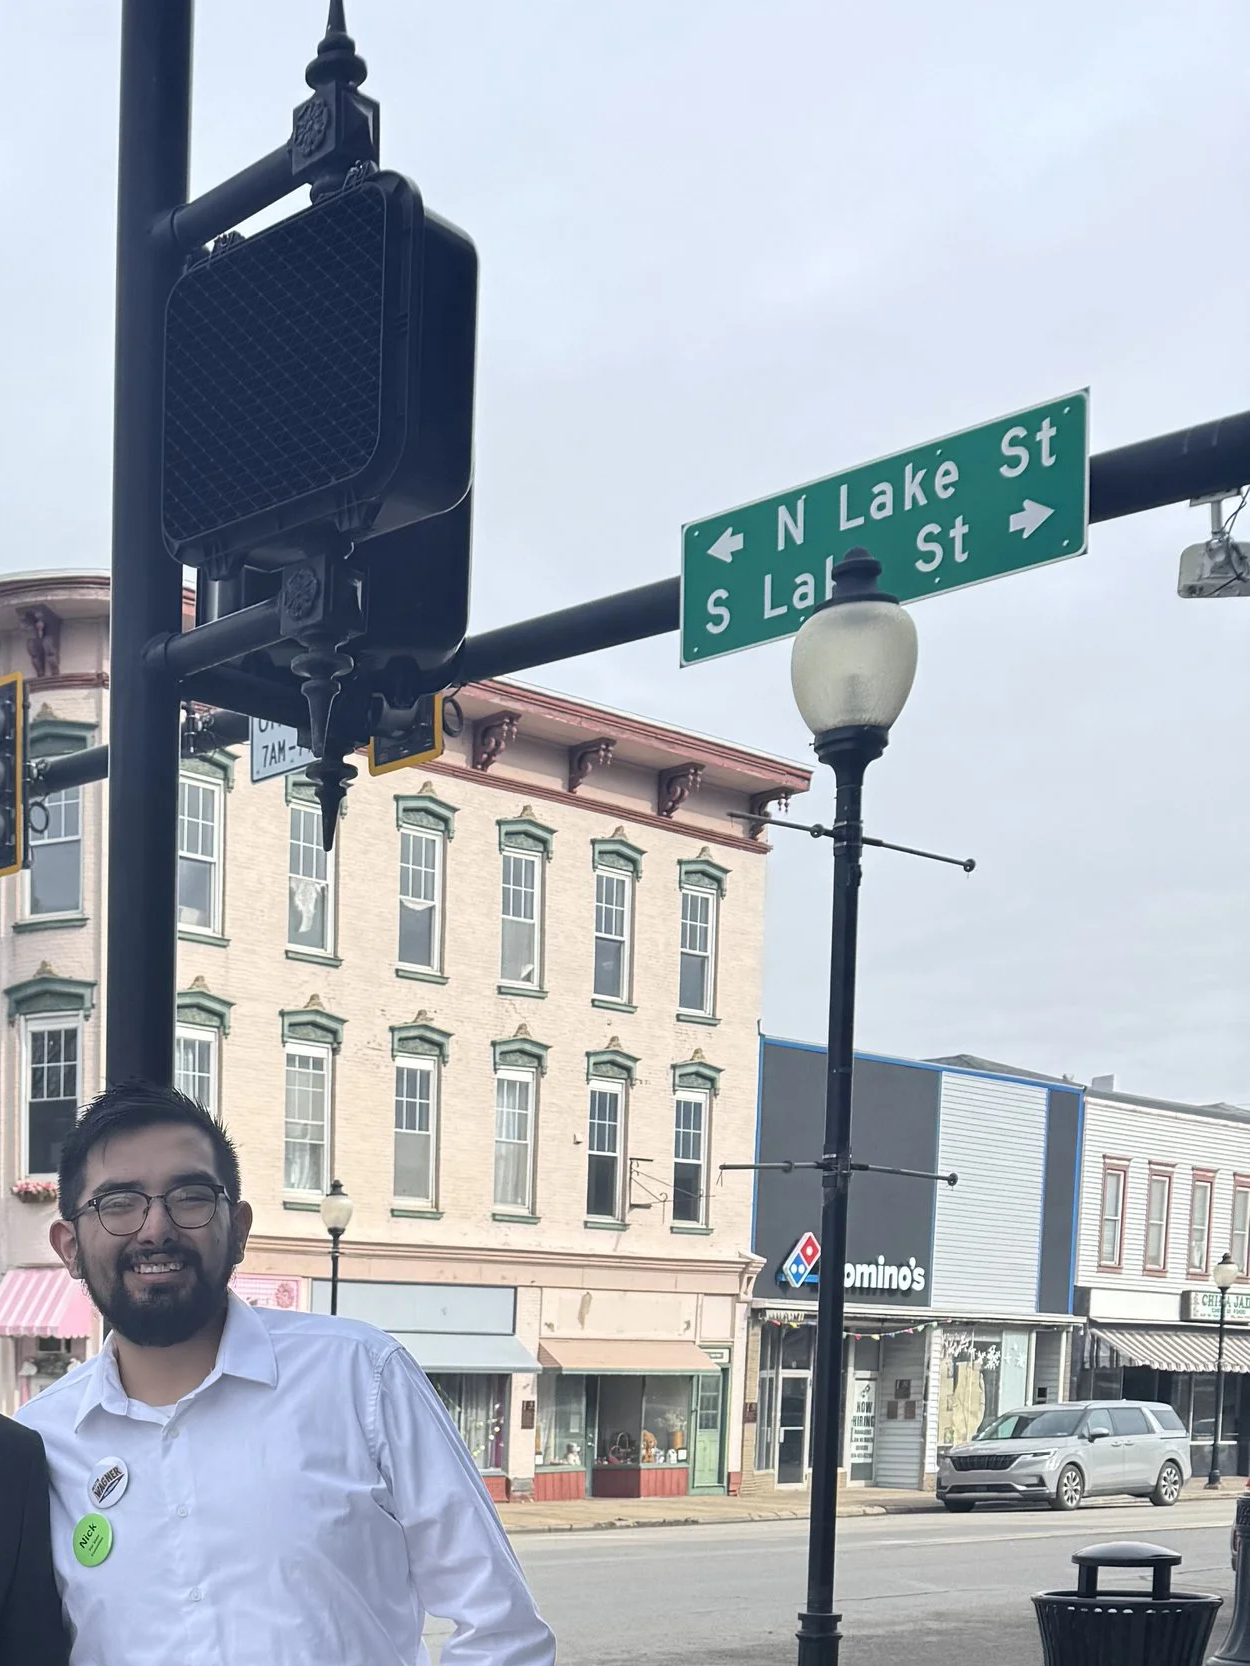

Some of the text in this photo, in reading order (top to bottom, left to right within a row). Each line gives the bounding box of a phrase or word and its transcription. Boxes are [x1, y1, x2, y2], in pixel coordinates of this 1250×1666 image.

[777, 417, 1057, 551] N Lake St
[705, 515, 970, 635] S La St
[844, 1253, 925, 1291] omino's
[1202, 1294, 1232, 1308] CHIA
[93, 1465, 124, 1501] WAGNER
[79, 1523, 98, 1549] Nick
